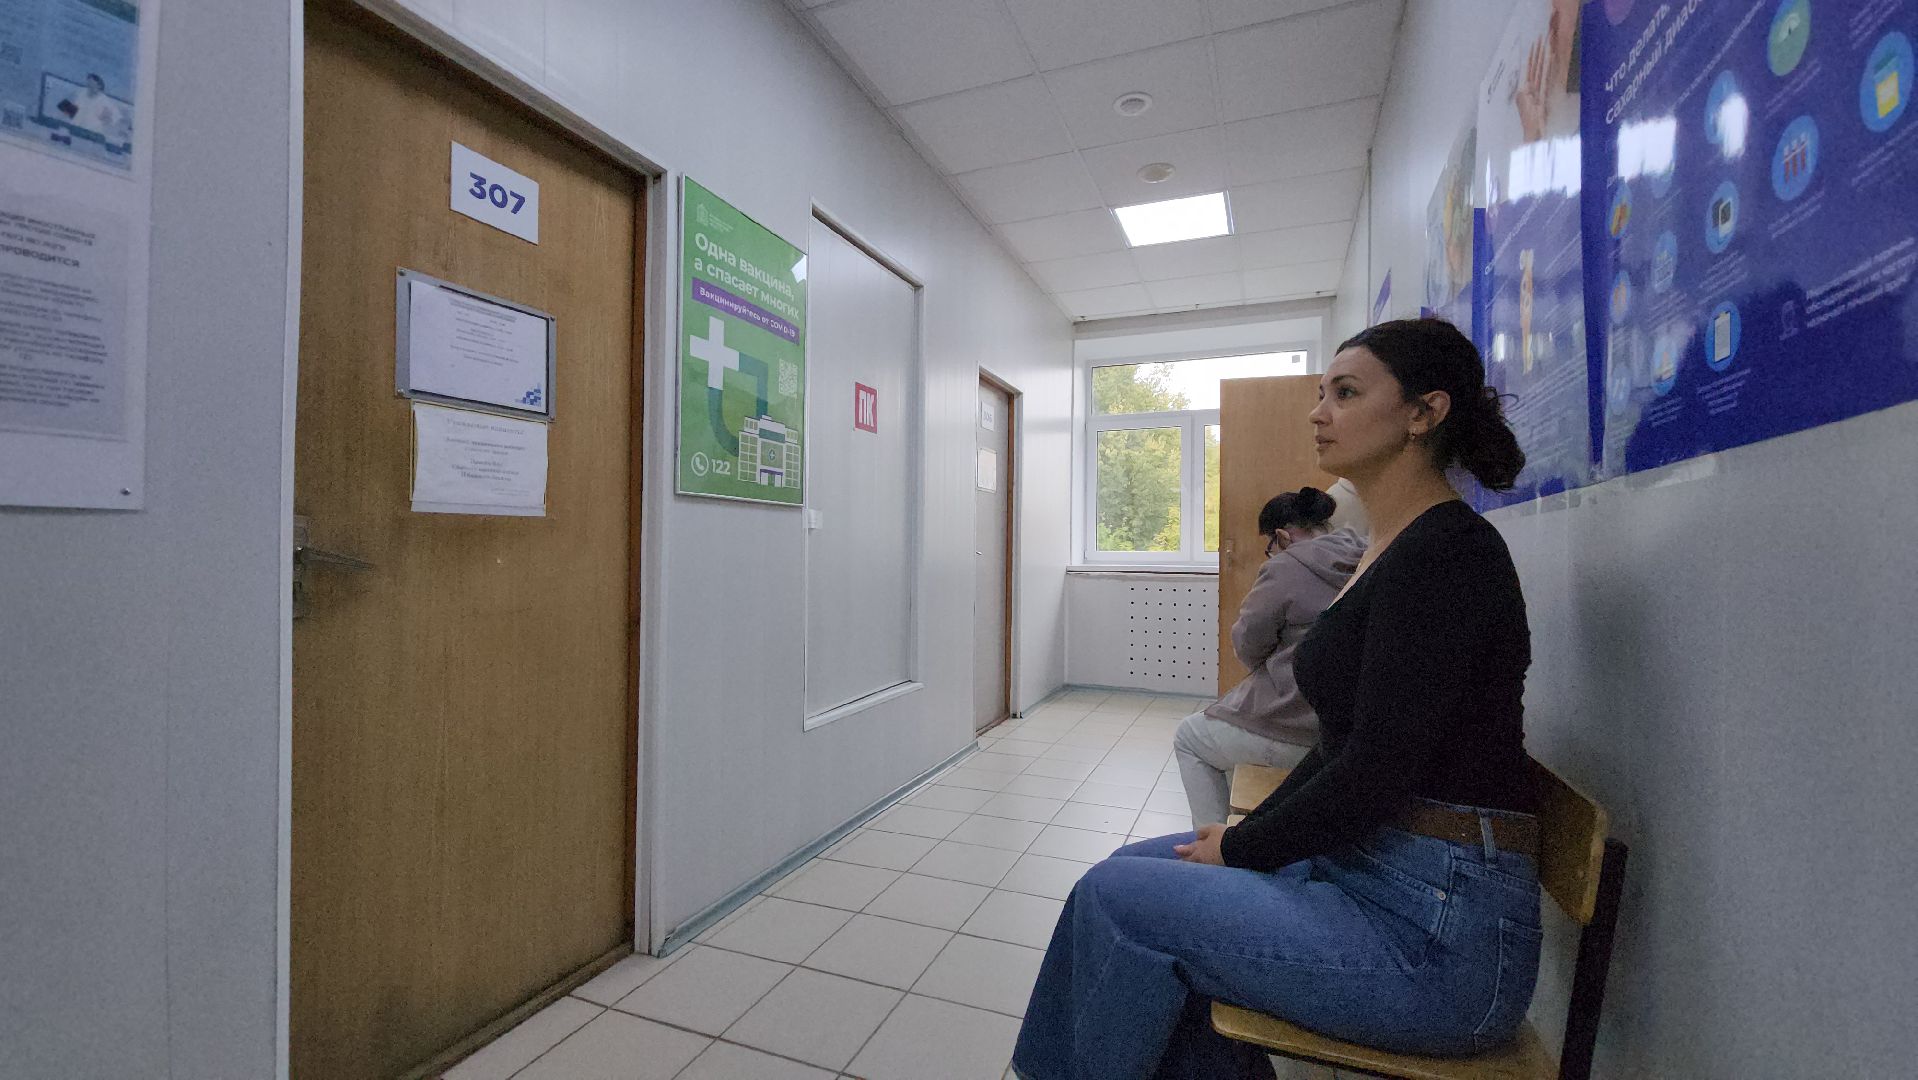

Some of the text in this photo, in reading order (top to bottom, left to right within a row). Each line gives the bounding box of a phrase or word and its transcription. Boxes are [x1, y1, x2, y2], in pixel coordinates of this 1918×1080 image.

[1605, 39, 1662, 124] сахарный
[469, 171, 526, 215] 307
[0, 244, 80, 268] ПРОВОДИТСЯ
[695, 232, 794, 301] Одна вакцина,
[694, 257, 799, 319] а спасает многих
[700, 287, 760, 321] Вакцинируйтесь
[762, 315, 770, 325] от
[859, 389, 875, 427] ПК
[712, 459, 731, 476] 122
